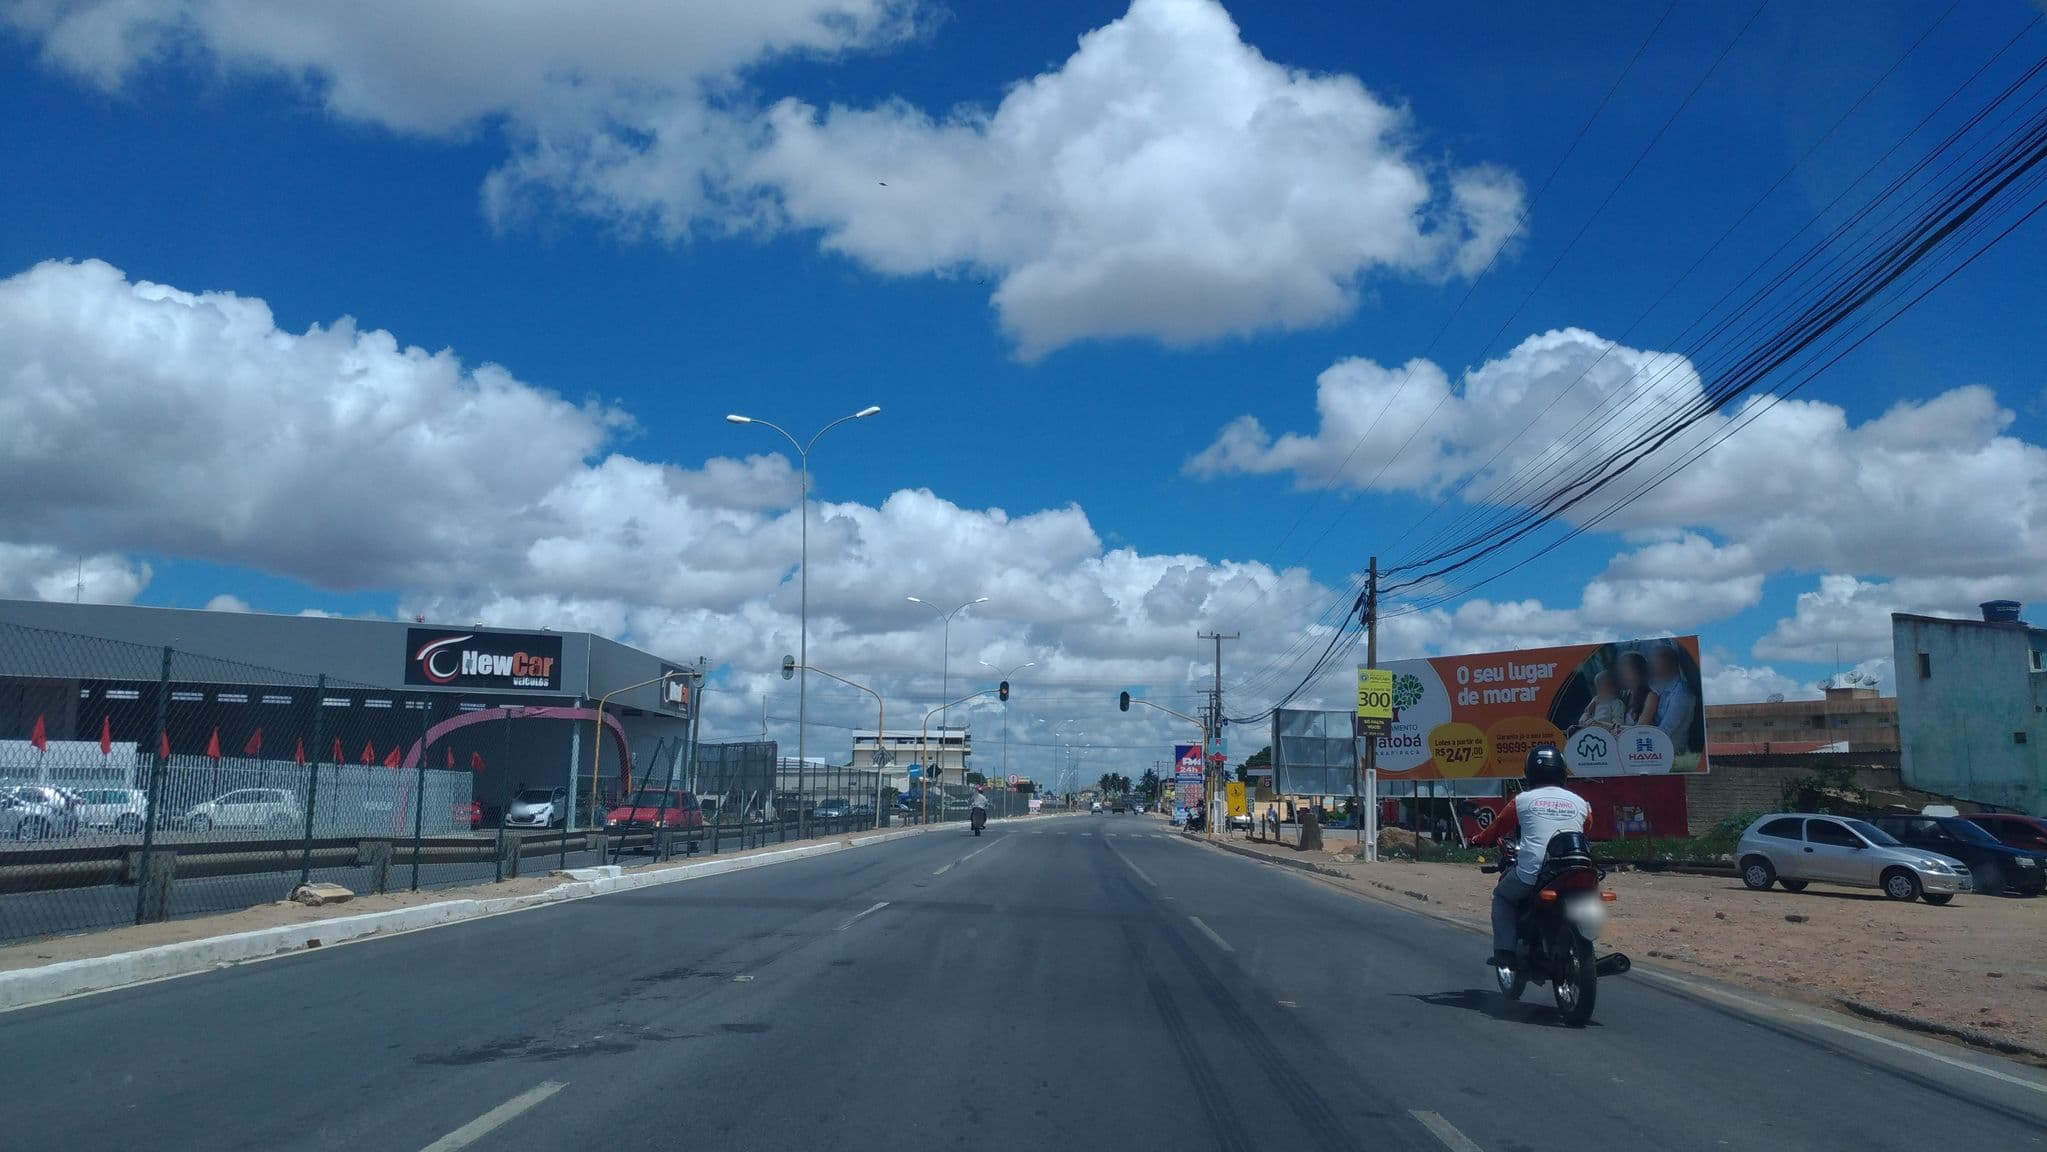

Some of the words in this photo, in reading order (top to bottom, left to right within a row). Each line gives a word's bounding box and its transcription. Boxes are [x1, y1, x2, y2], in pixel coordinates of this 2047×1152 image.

[461, 650, 554, 677] NewCar
[1456, 665, 1470, 685] O
[1473, 666, 1504, 684] seu
[1508, 661, 1558, 684] lugar
[1358, 691, 1390, 708] 300
[1458, 687, 1479, 706] de
[1483, 686, 1540, 705] morar
[1375, 733, 1422, 749] atobá
